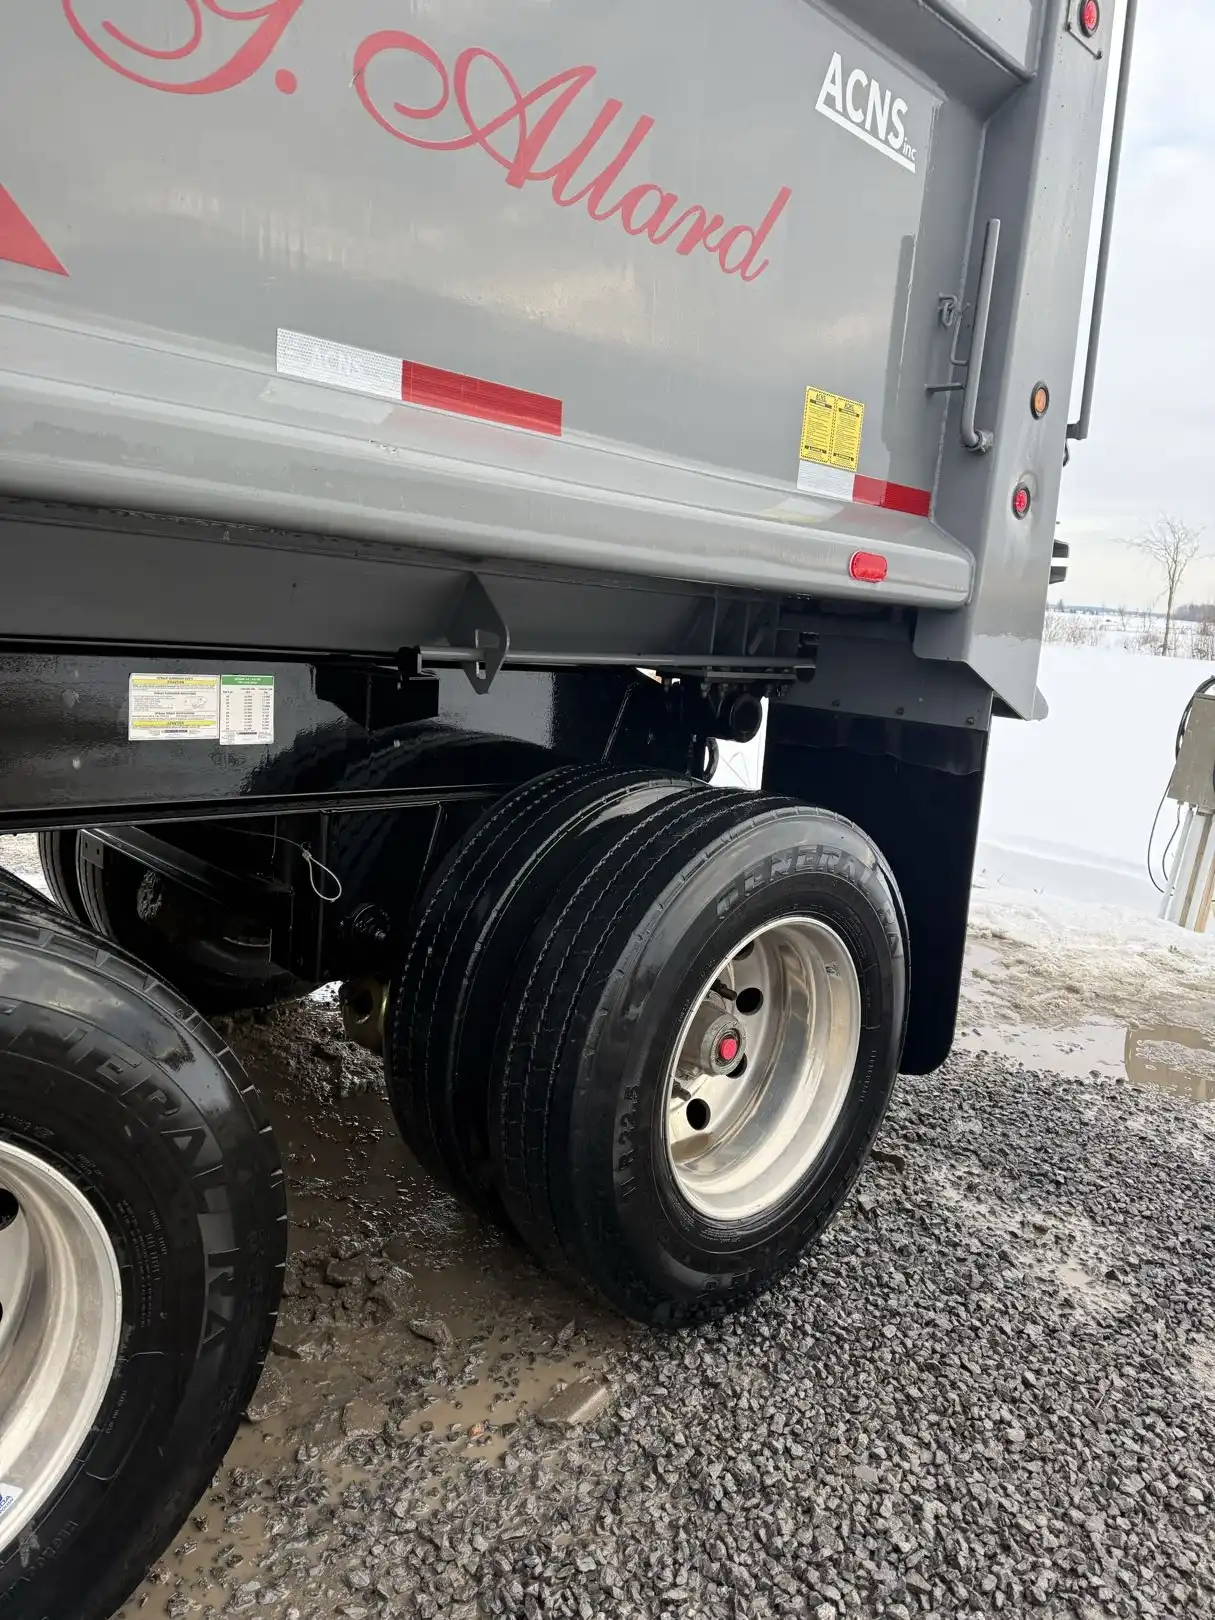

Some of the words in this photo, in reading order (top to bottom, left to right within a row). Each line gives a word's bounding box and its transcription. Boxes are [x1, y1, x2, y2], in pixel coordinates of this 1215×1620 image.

[353, 29, 792, 282] Allard
[815, 51, 909, 150] ACNS
[902, 137, 917, 161] inc
